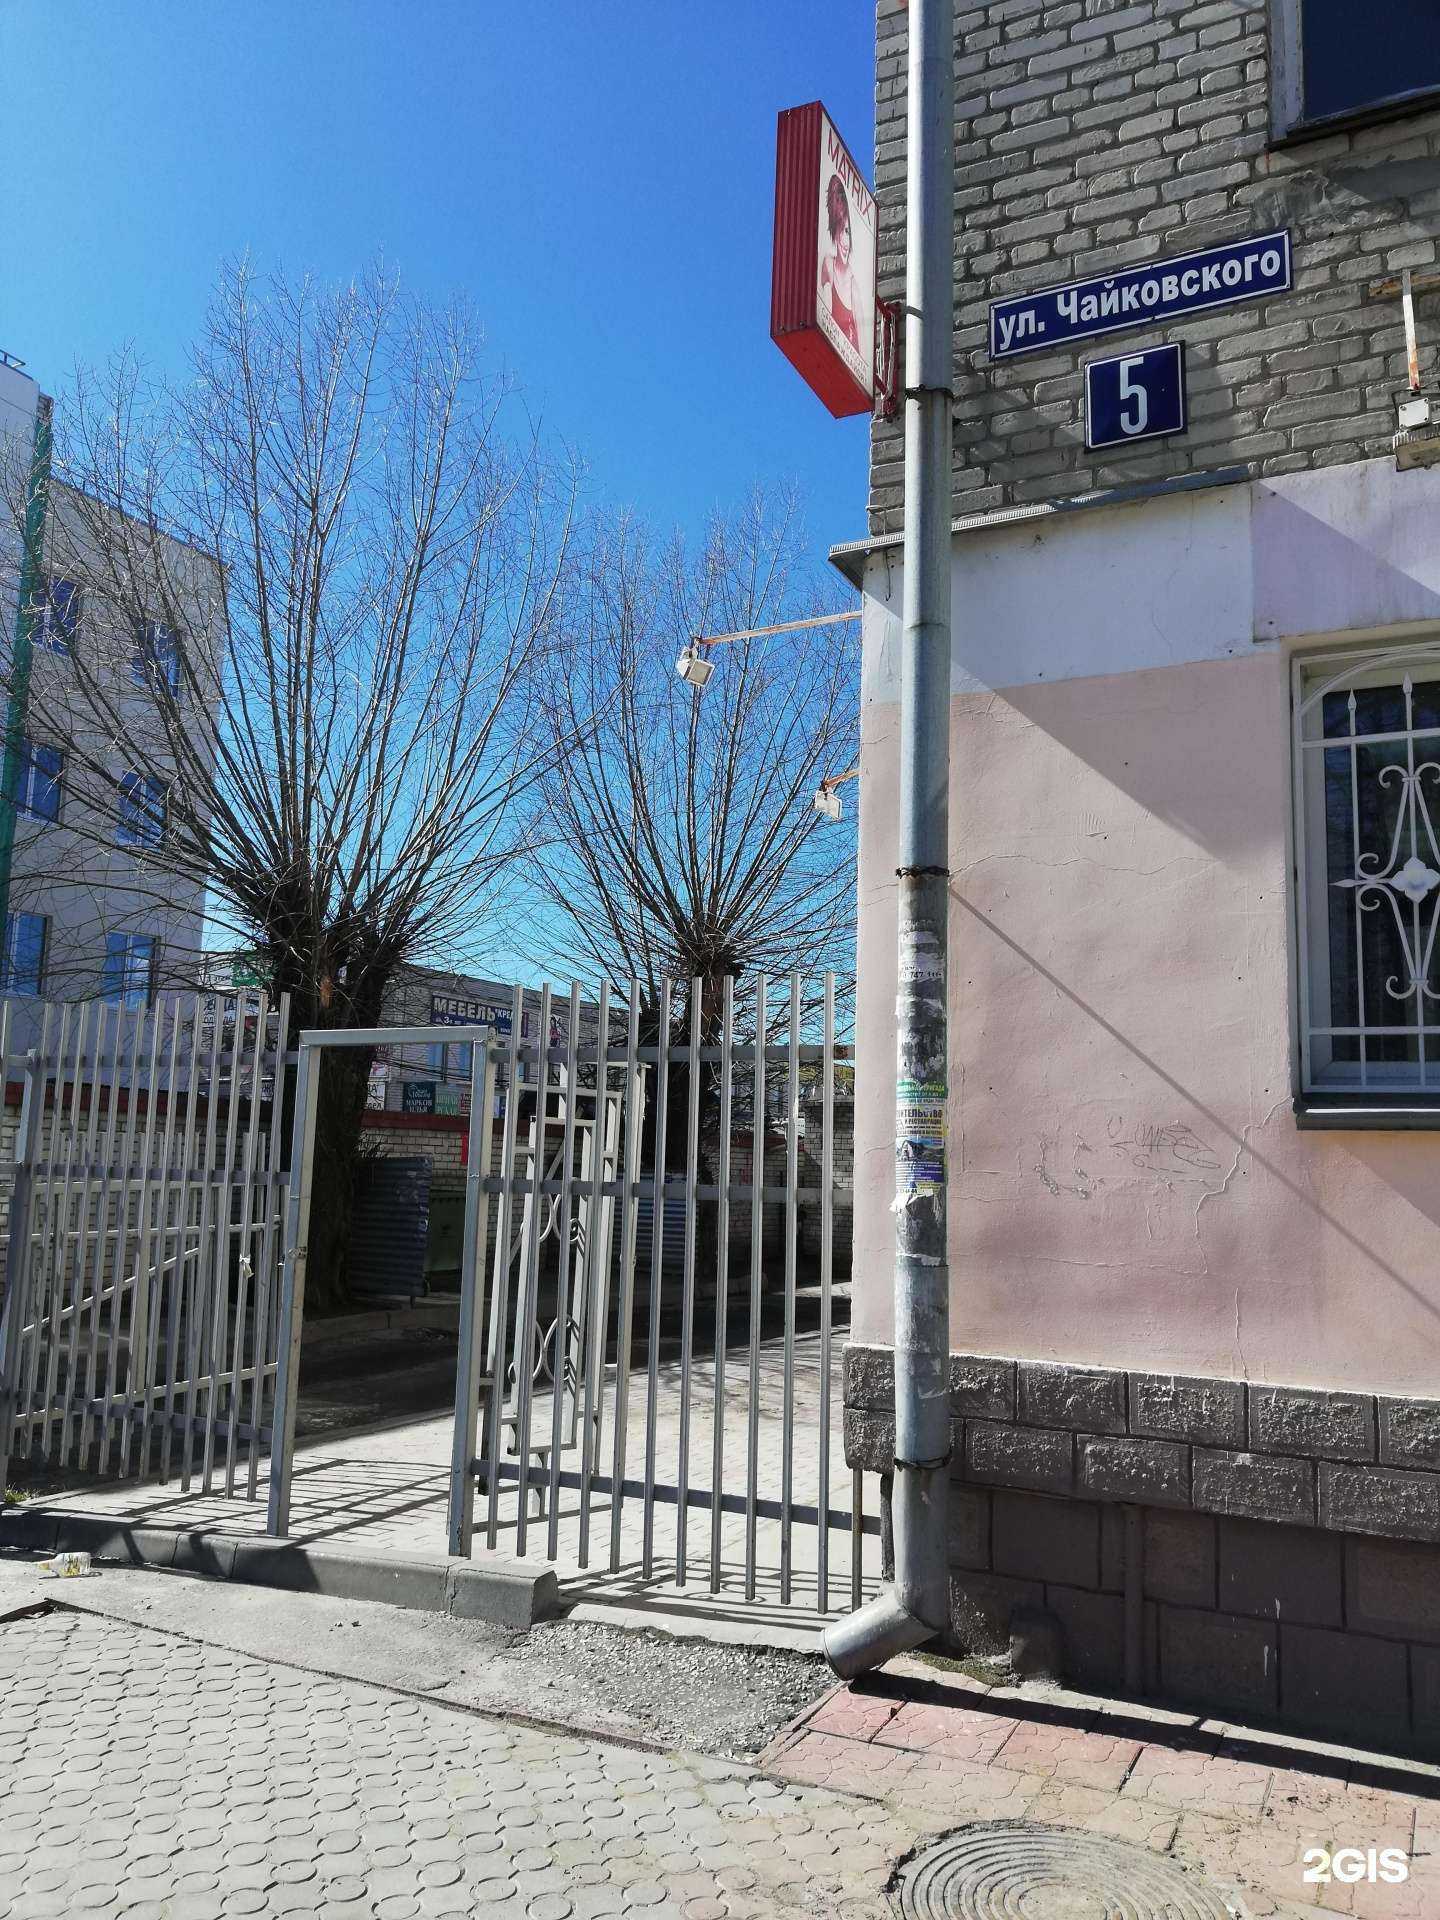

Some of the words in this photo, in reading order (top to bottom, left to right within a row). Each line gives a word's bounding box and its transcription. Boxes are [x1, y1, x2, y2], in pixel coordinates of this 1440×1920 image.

[828, 128, 872, 226] MATRIX
[999, 310, 1045, 350] ул.
[1057, 250, 1281, 324] Чайковского
[1119, 356, 1148, 435] 5
[433, 997, 496, 1022] МЕБЕЛЬ
